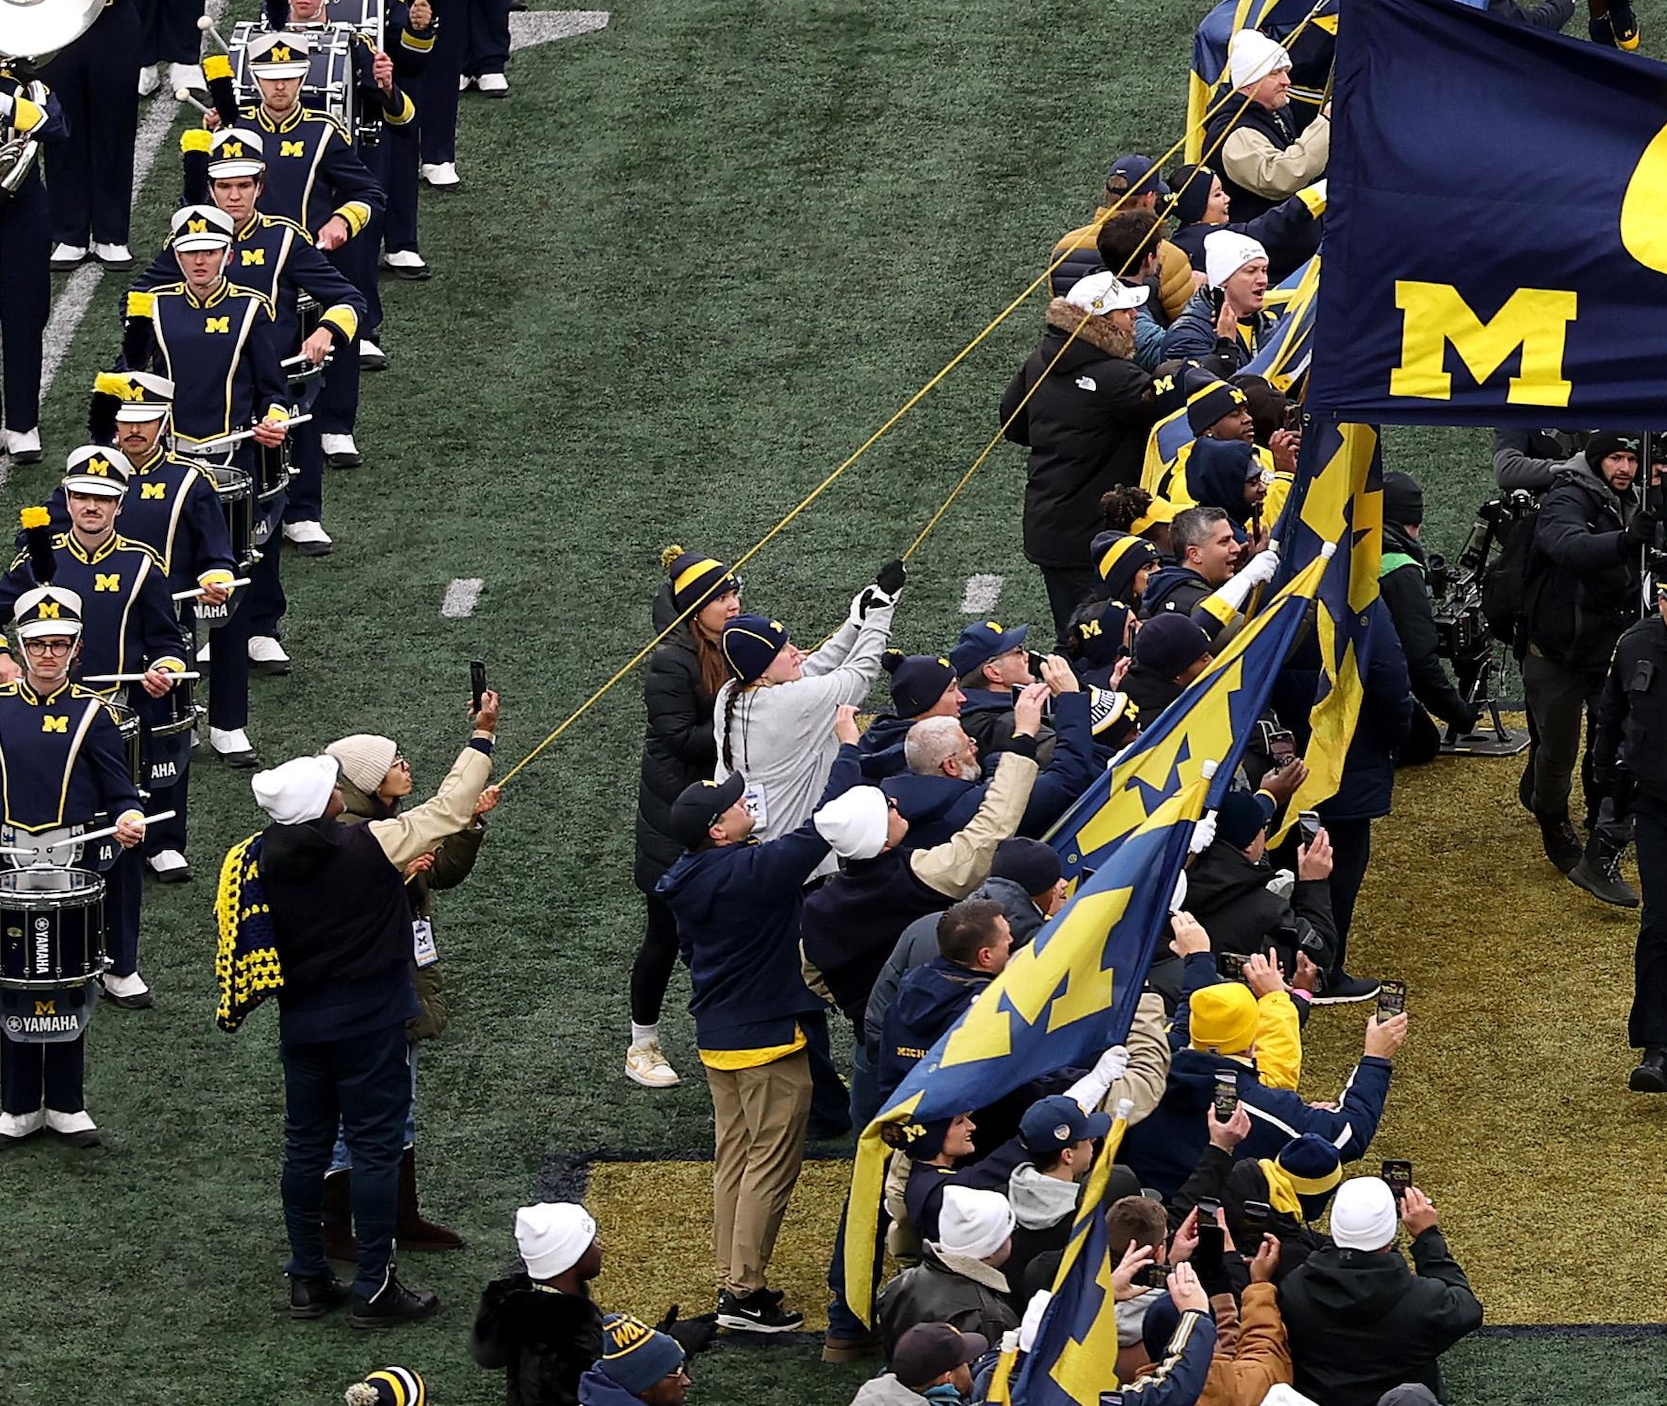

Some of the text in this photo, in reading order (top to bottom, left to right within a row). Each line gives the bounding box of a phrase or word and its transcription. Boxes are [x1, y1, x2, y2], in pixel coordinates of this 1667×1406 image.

[271, 46, 291, 63] M
[280, 142, 304, 156] M
[187, 220, 208, 234] M
[241, 249, 265, 264] M
[205, 317, 230, 332] M
[1390, 280, 1577, 407] M
[1154, 375, 1174, 395] M
[1230, 388, 1247, 404] M
[86, 457, 109, 477] M
[142, 483, 166, 499] M
[95, 575, 121, 591] M
[1080, 620, 1102, 639] M
[1123, 700, 1140, 722] M
[43, 715, 69, 731] M
[151, 762, 177, 779] AHA
[35, 930, 48, 975] YAMAHA
[35, 1000, 56, 1015] M
[22, 1014, 80, 1034] YAMAHA
[903, 1125, 926, 1142] M
